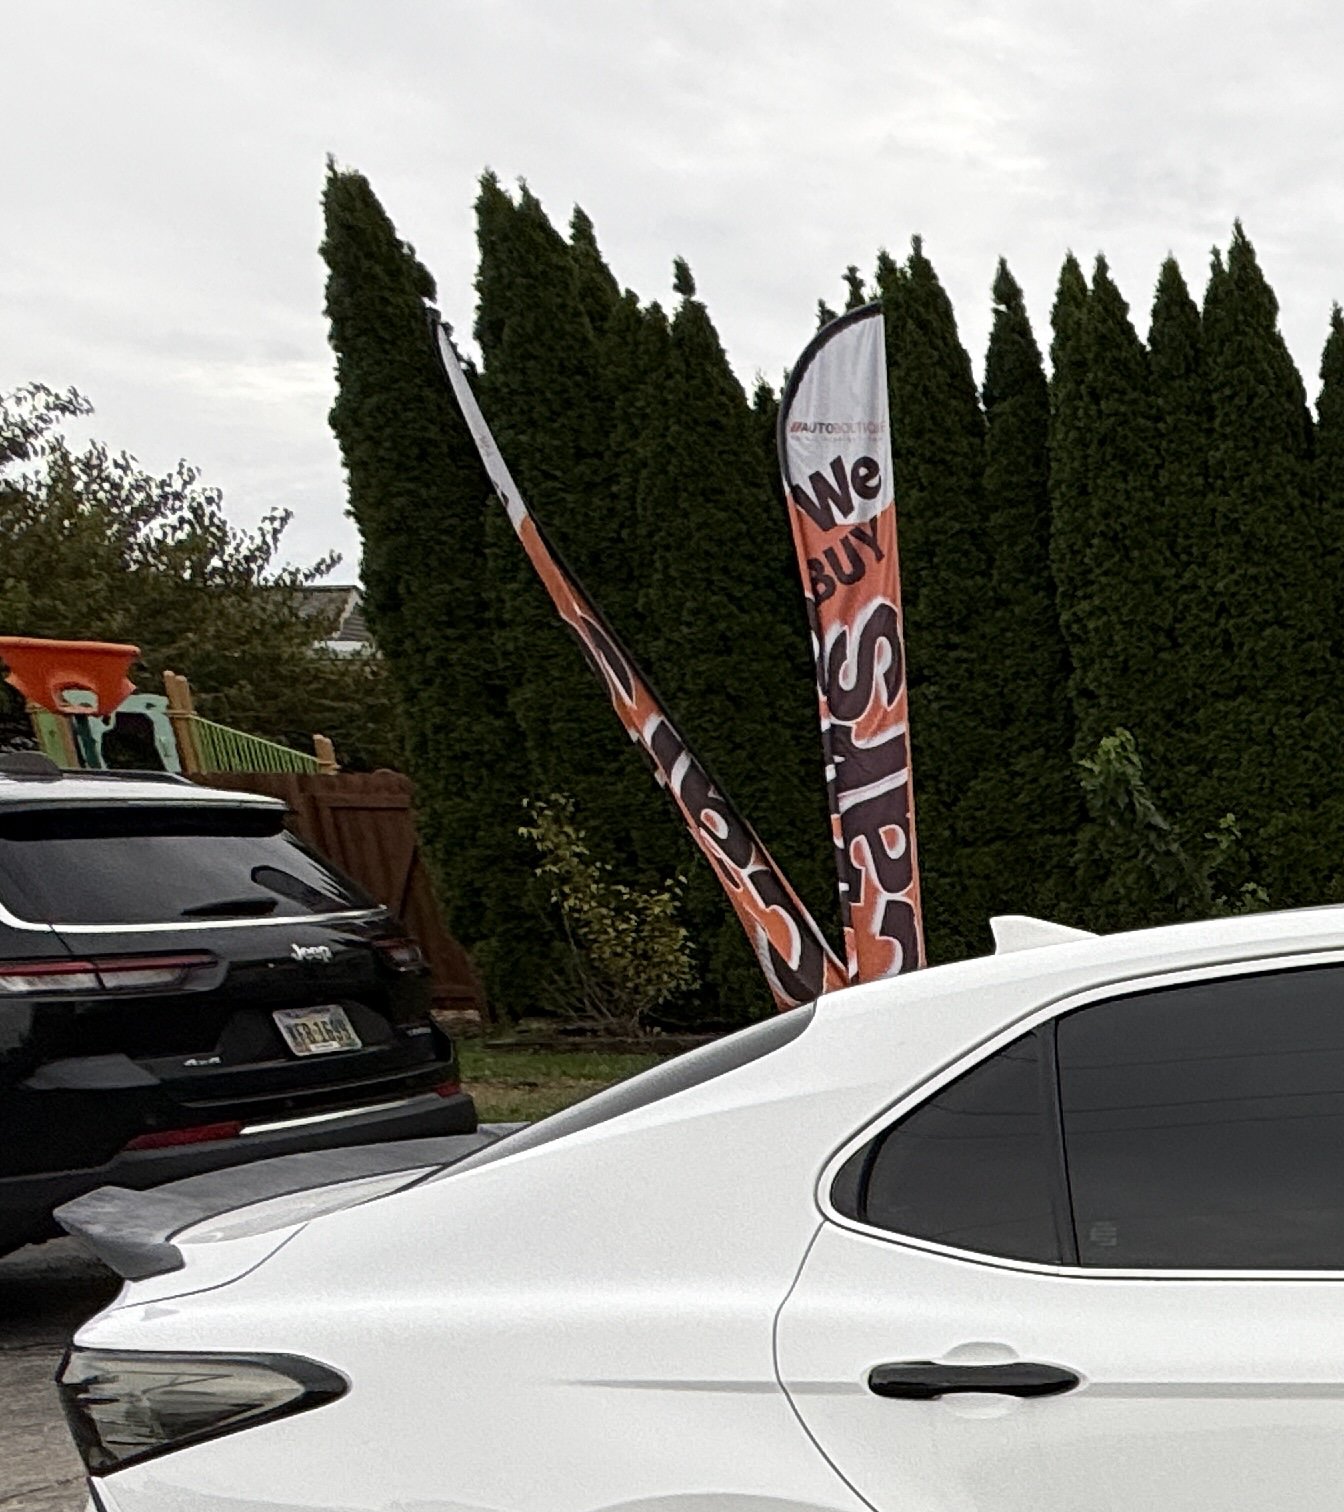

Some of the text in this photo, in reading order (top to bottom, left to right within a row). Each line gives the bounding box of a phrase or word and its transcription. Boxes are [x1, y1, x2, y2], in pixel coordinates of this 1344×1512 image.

[791, 454, 882, 532] We
[806, 515, 886, 606] BUY
[291, 943, 334, 963] Jeep
